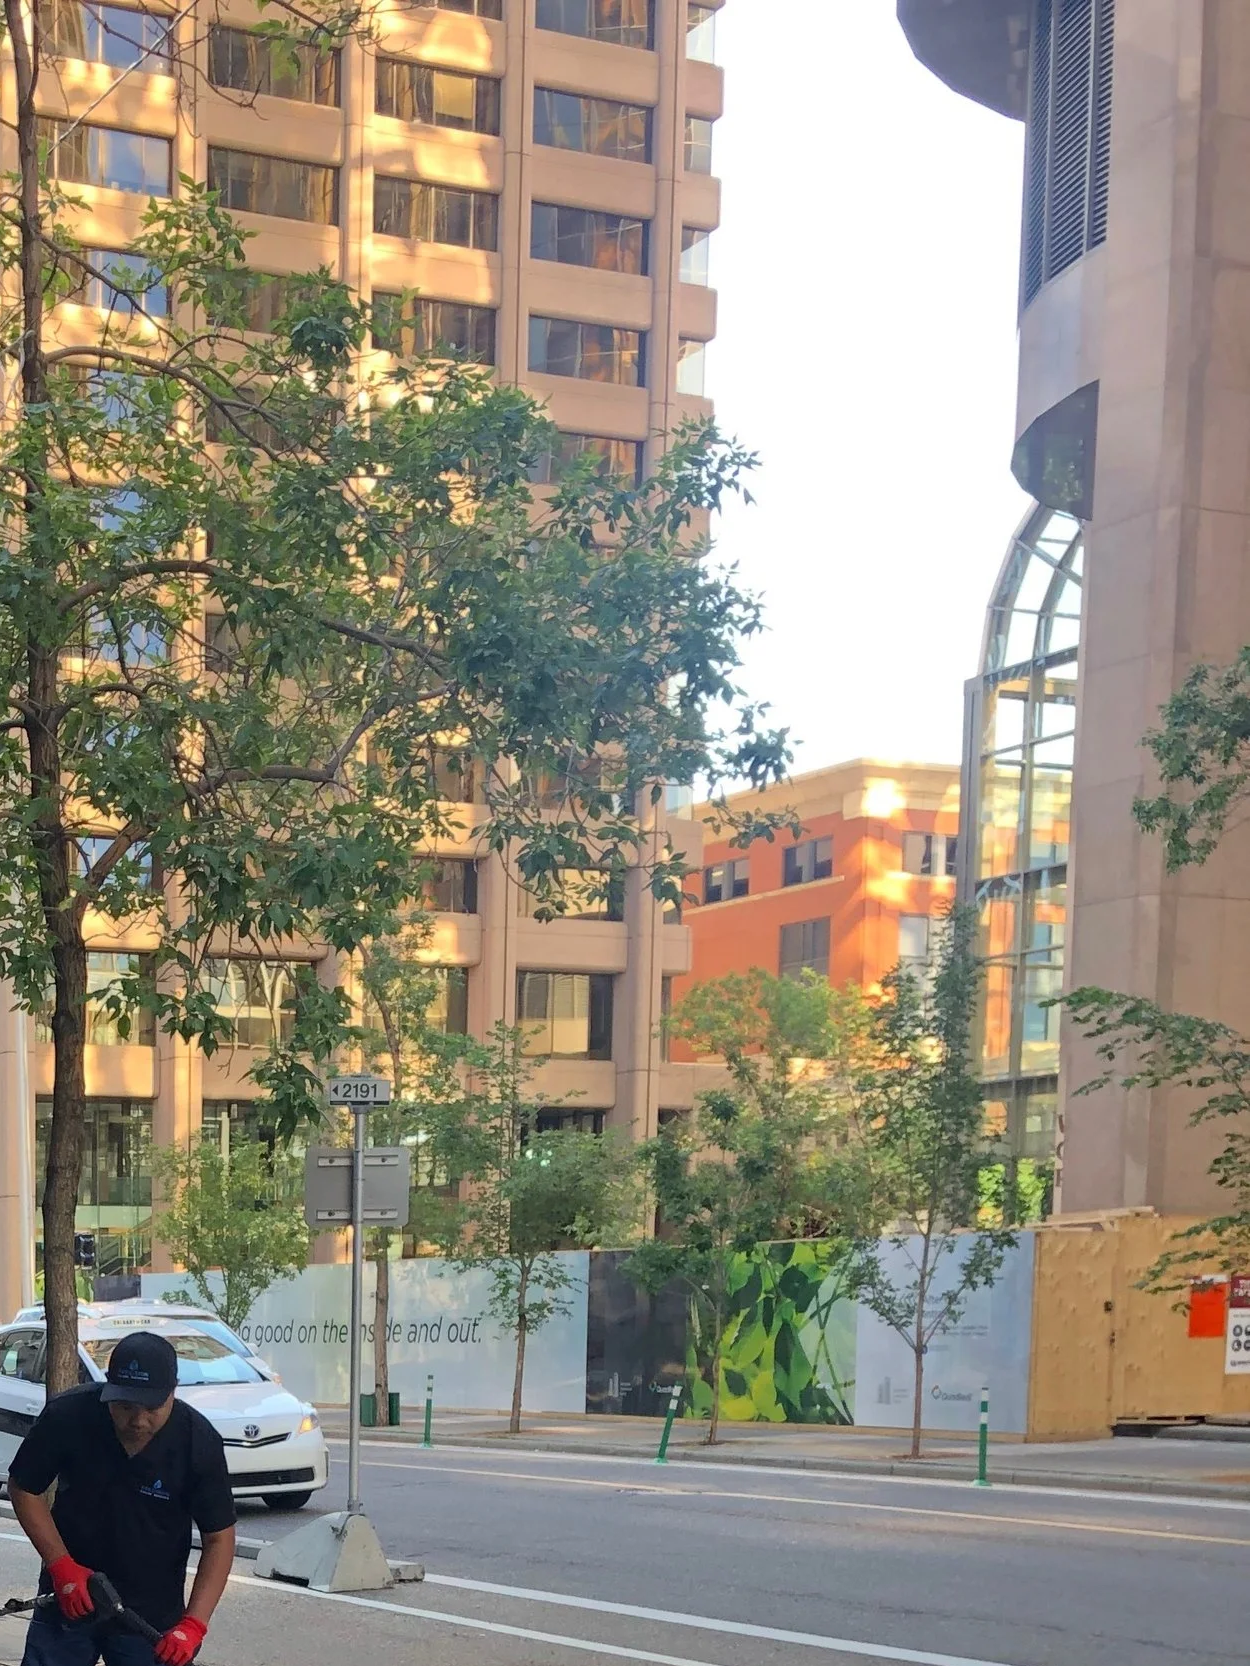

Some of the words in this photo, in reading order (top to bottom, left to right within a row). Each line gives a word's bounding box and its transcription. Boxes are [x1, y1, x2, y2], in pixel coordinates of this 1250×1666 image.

[342, 1083, 377, 1098] 2191
[254, 1319, 294, 1348] good
[297, 1324, 318, 1344] on
[322, 1318, 349, 1344] the
[359, 1317, 402, 1343] nsde
[407, 1316, 443, 1343] and
[447, 1318, 481, 1343] out.
